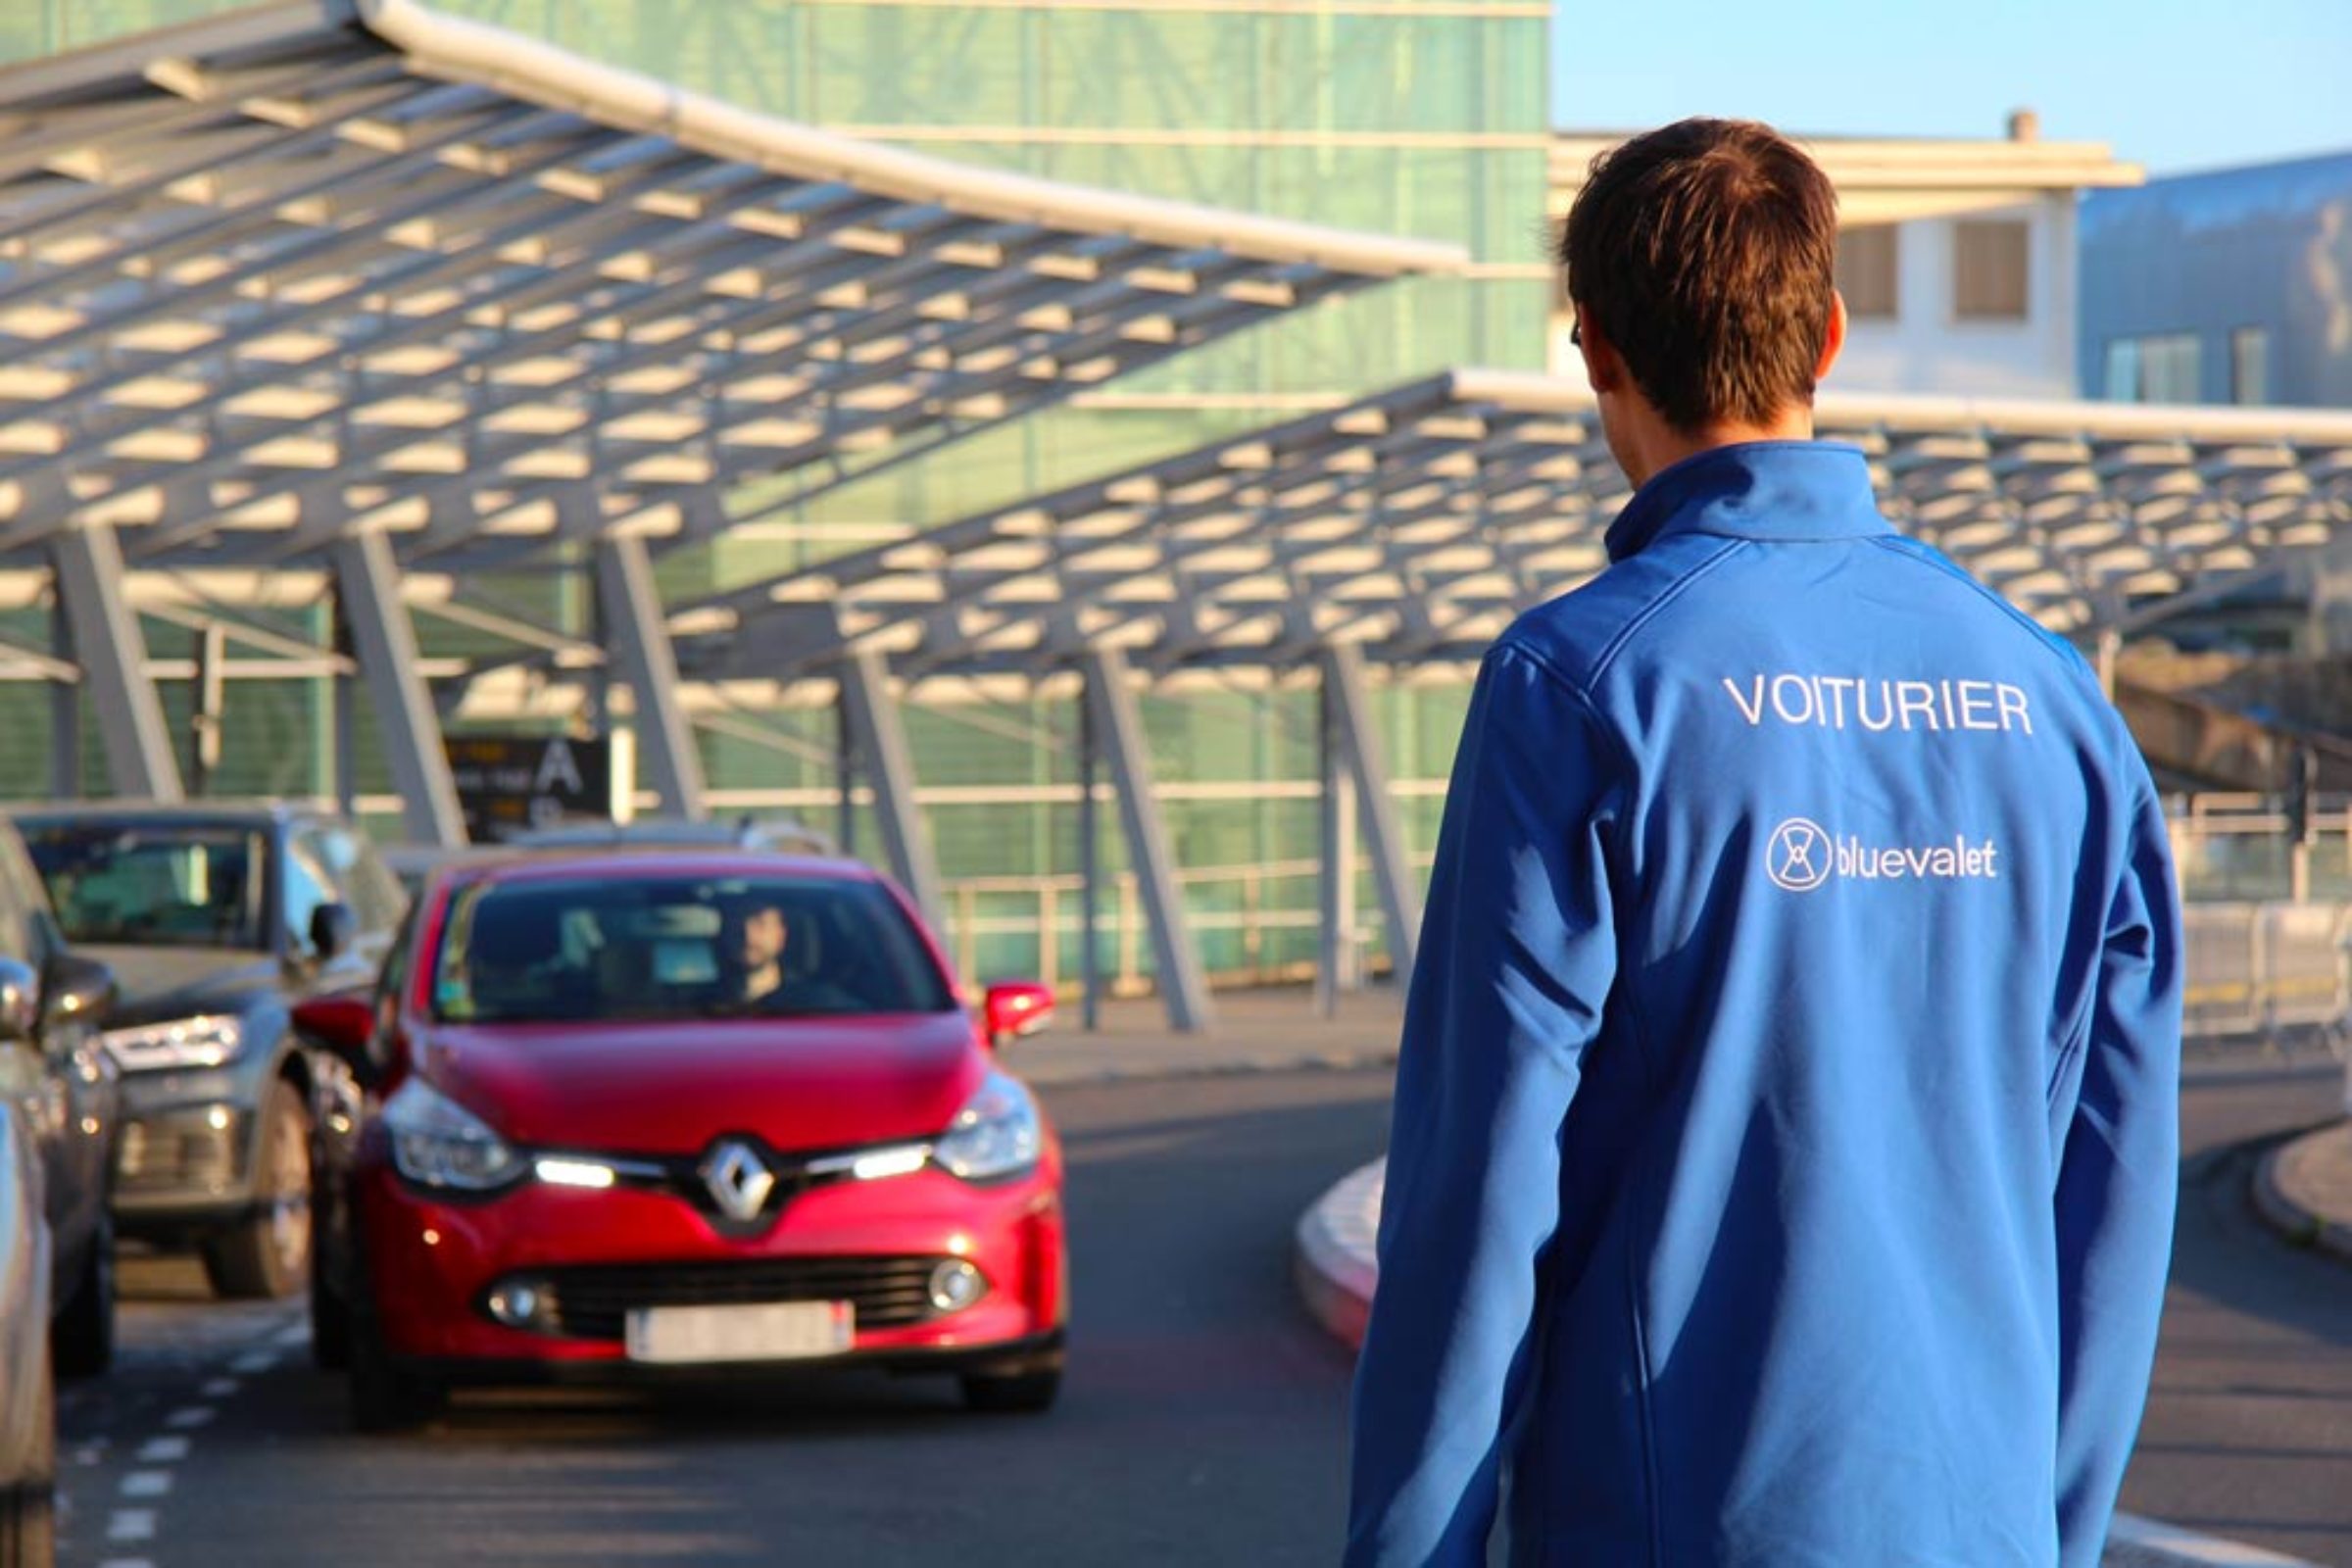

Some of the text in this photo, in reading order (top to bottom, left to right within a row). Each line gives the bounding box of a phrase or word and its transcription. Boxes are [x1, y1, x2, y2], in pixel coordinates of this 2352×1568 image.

[1723, 674, 2033, 735] VOITURIER
[536, 737, 585, 795] A
[1836, 834, 1998, 878] bluevalet
